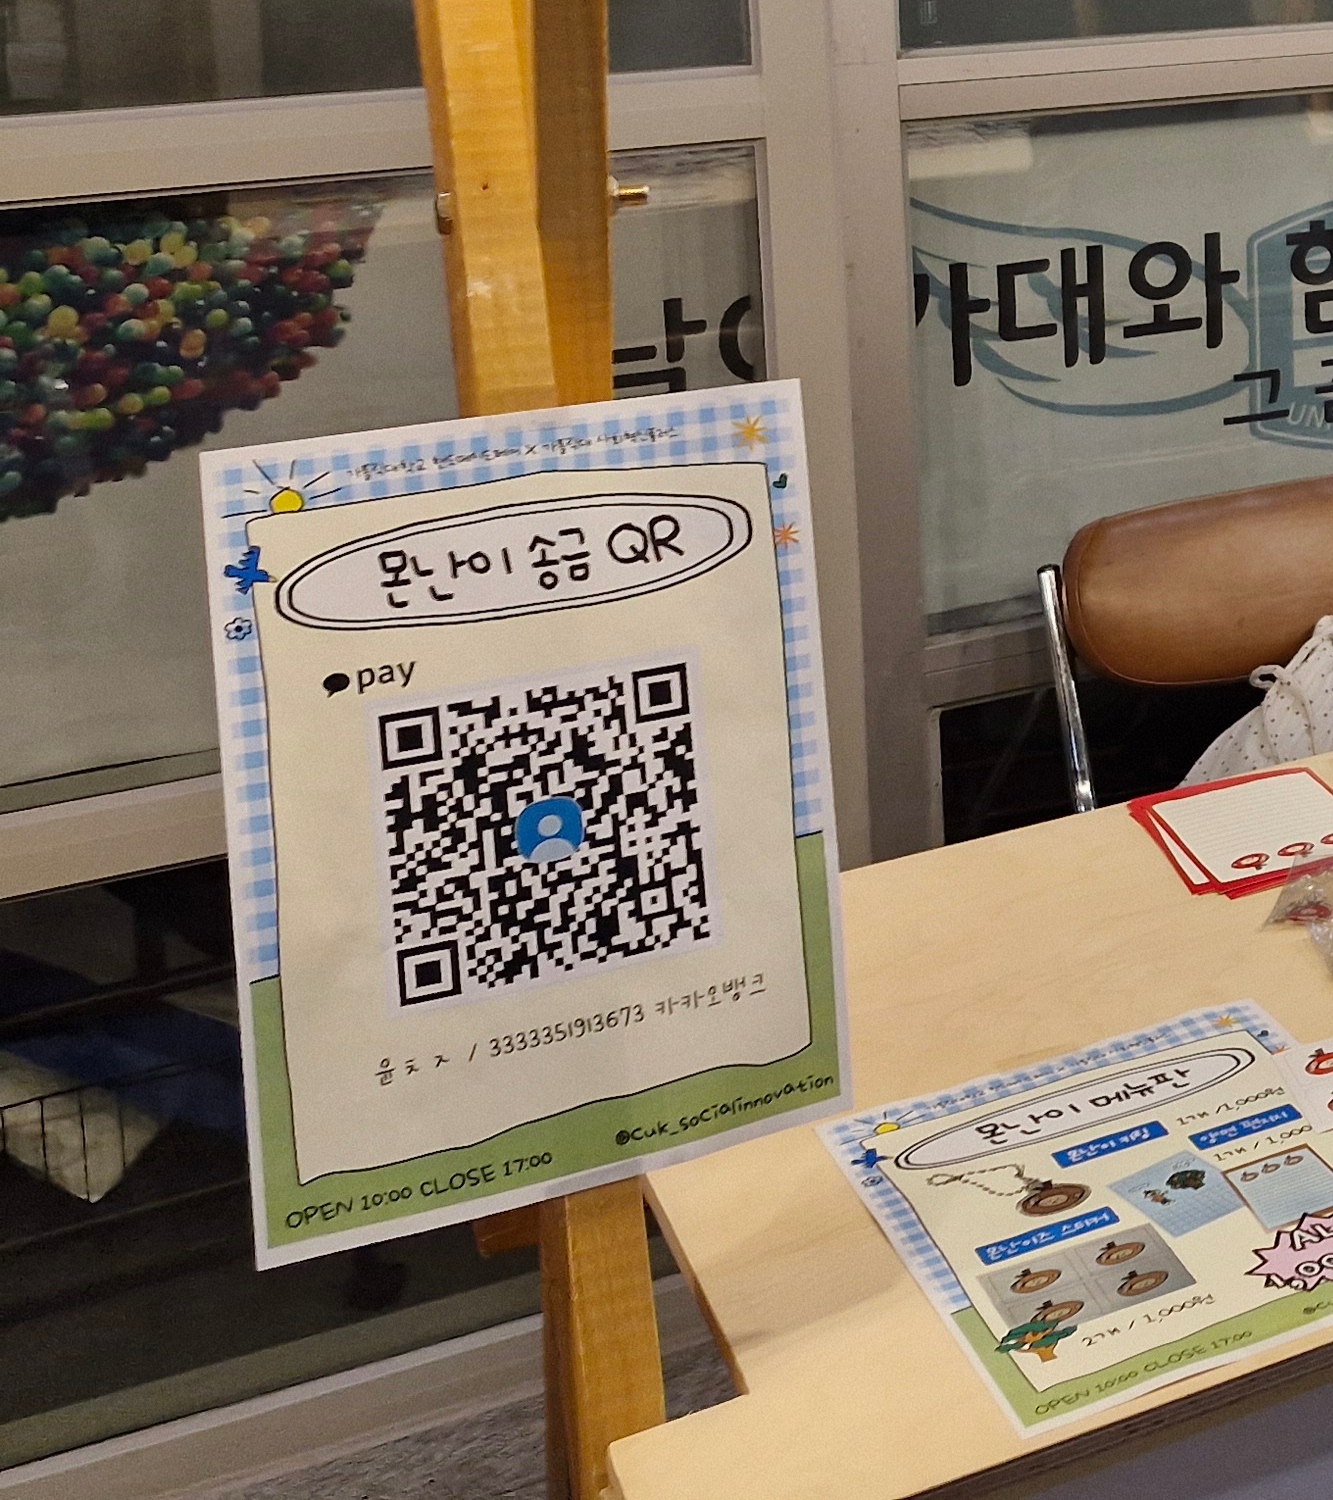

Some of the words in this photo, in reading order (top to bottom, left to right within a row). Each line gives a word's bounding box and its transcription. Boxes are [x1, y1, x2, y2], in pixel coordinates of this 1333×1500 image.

[1223, 369, 1289, 425] 그
[528, 528, 590, 590] 송금
[607, 514, 684, 564] QR
[357, 660, 416, 694] pay
[488, 1003, 645, 1058] 3333351913673
[654, 972, 767, 1017] 카카오뱅크
[1088, 1069, 1191, 1107] 메뉴판
[283, 1194, 355, 1231] OPEN
[360, 1184, 413, 1213] 10:00
[419, 1162, 497, 1199] CLOSE
[502, 1151, 553, 1179] 17:00
[1033, 1387, 1091, 1417] OPEN
[1094, 1369, 1140, 1397] 10:00
[1142, 1345, 1207, 1374] CLOSE
[1209, 1329, 1254, 1352] 17:00
